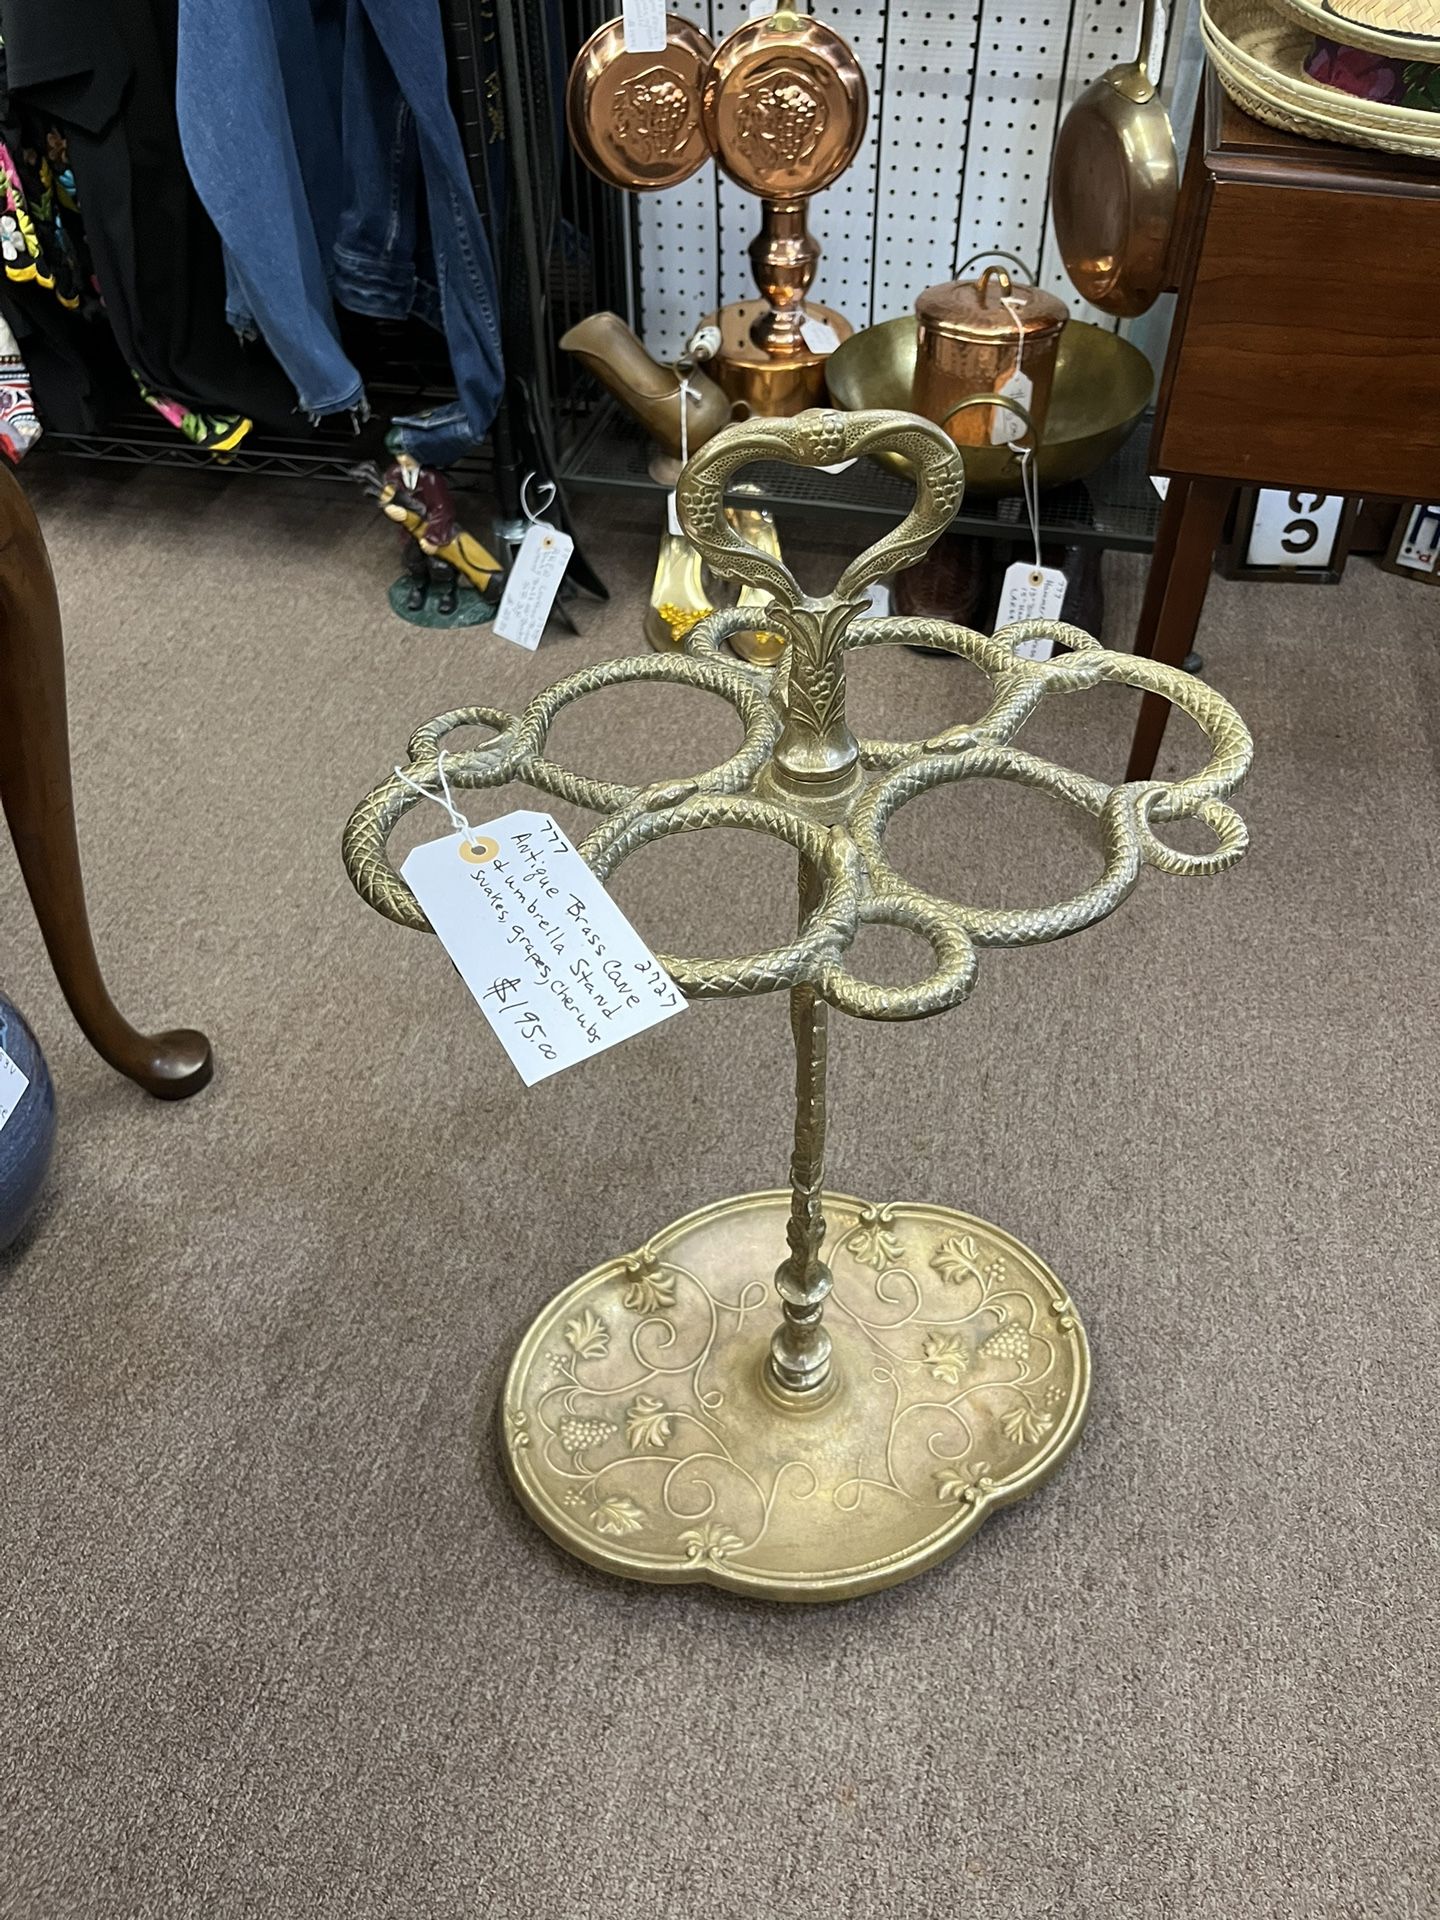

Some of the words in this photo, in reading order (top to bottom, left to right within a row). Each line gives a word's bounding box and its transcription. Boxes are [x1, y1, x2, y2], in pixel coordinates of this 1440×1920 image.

[504, 874, 566, 956] umbrella
[568, 958, 622, 1021] Stand
[510, 832, 560, 899] Antique
[566, 893, 606, 957] Brass
[540, 819, 569, 853] 777
[634, 960, 678, 1008] 2727
[482, 976, 558, 1061] $195.00
